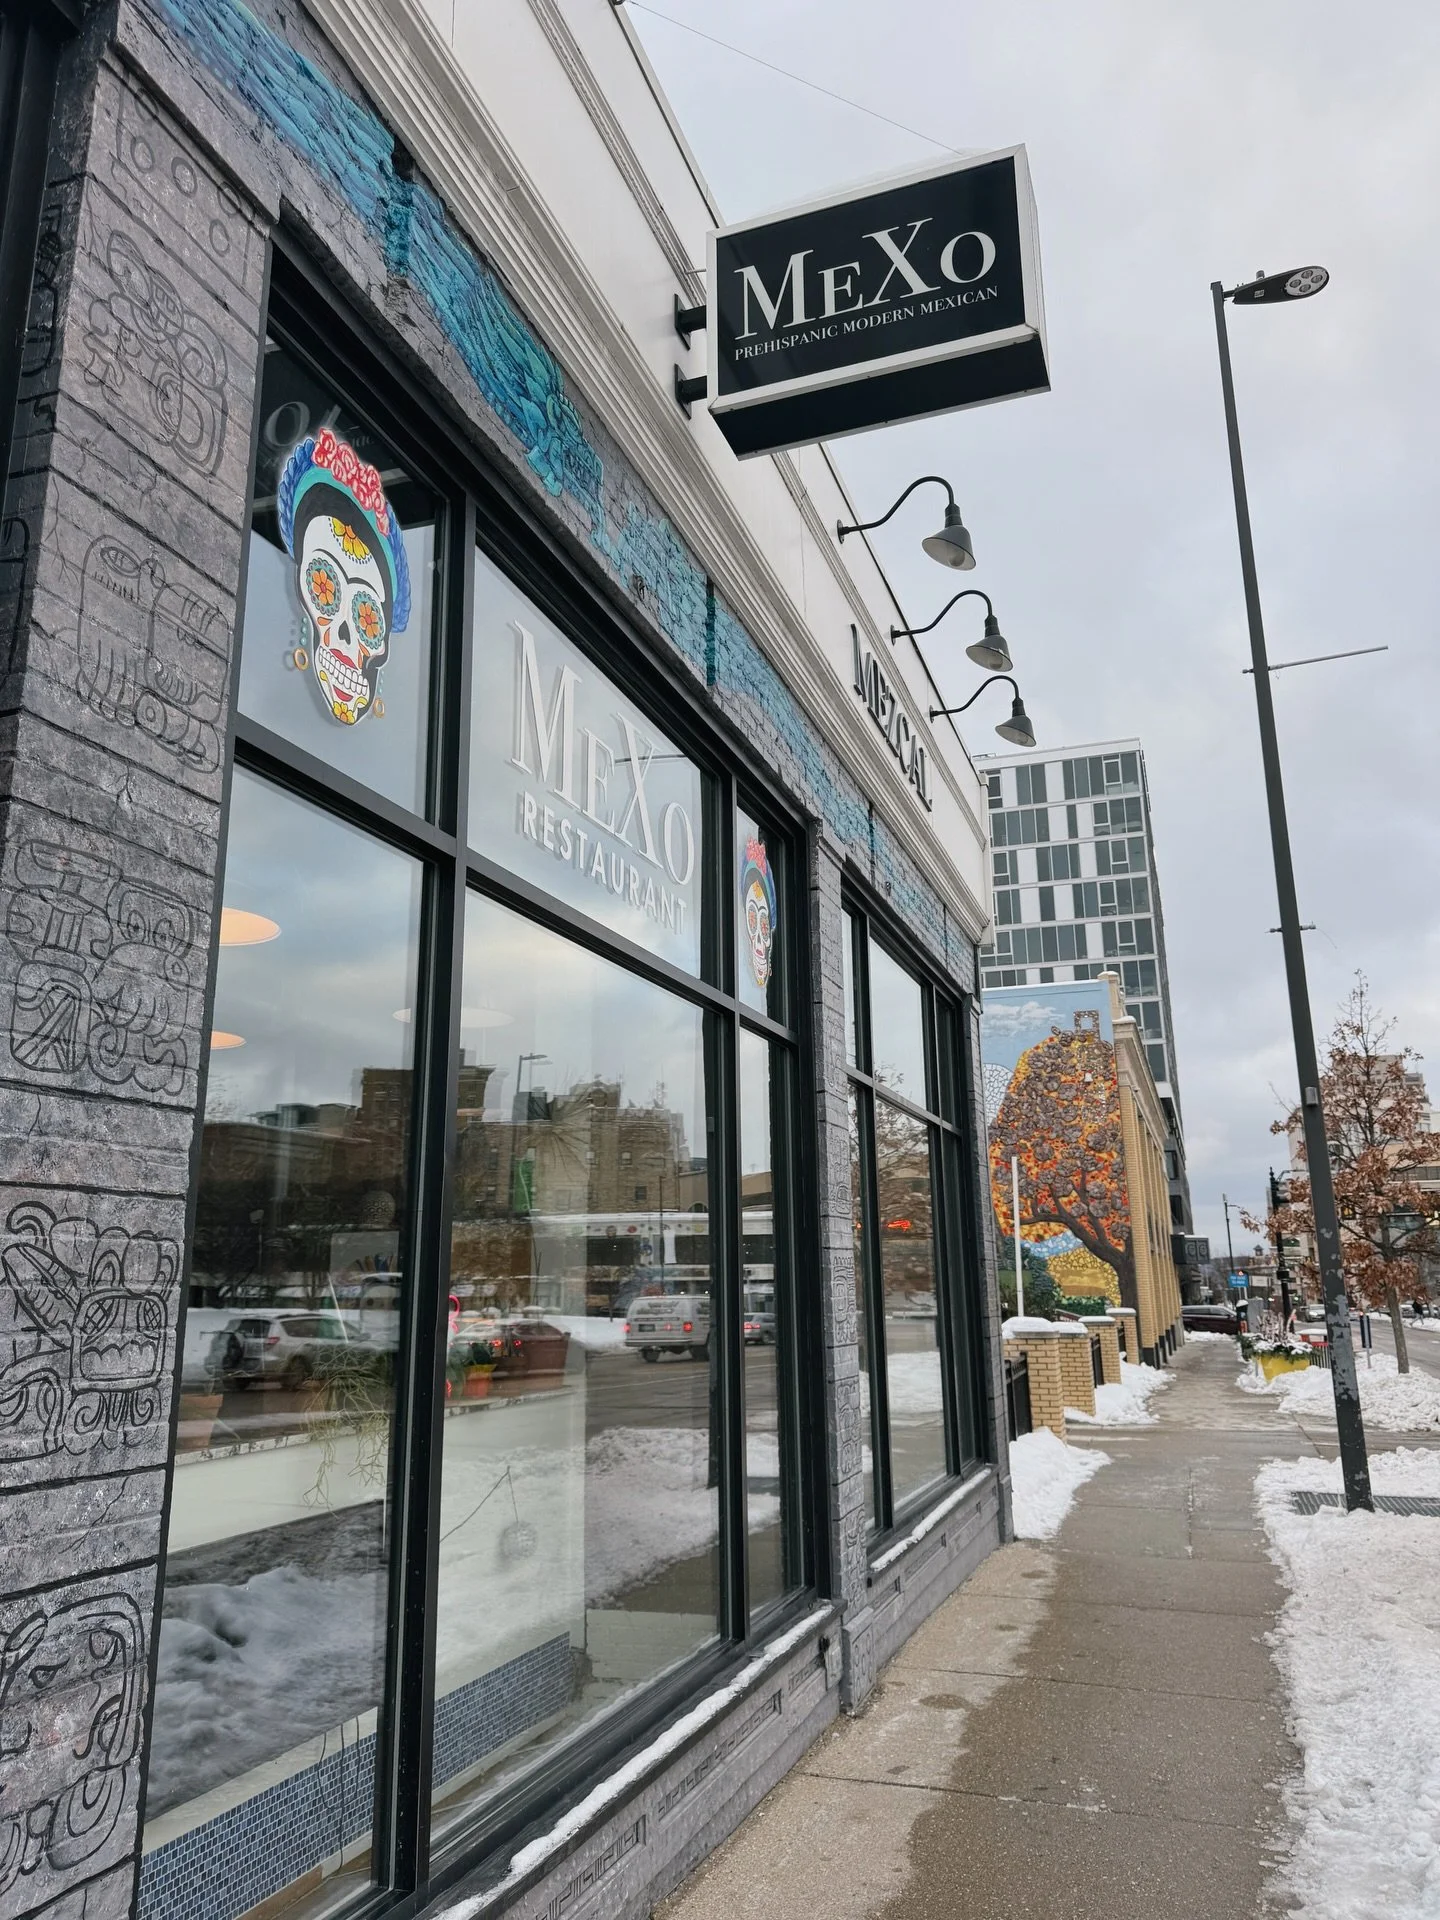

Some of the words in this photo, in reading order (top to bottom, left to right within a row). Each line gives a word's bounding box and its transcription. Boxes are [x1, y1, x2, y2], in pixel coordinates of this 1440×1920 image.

[734, 324, 838, 361] PREHISPANIC
[842, 305, 915, 335] MODERN
[919, 285, 998, 316] MEXICAN
[850, 623, 932, 812] MEZCAL
[519, 790, 687, 935] RESTAURANT
